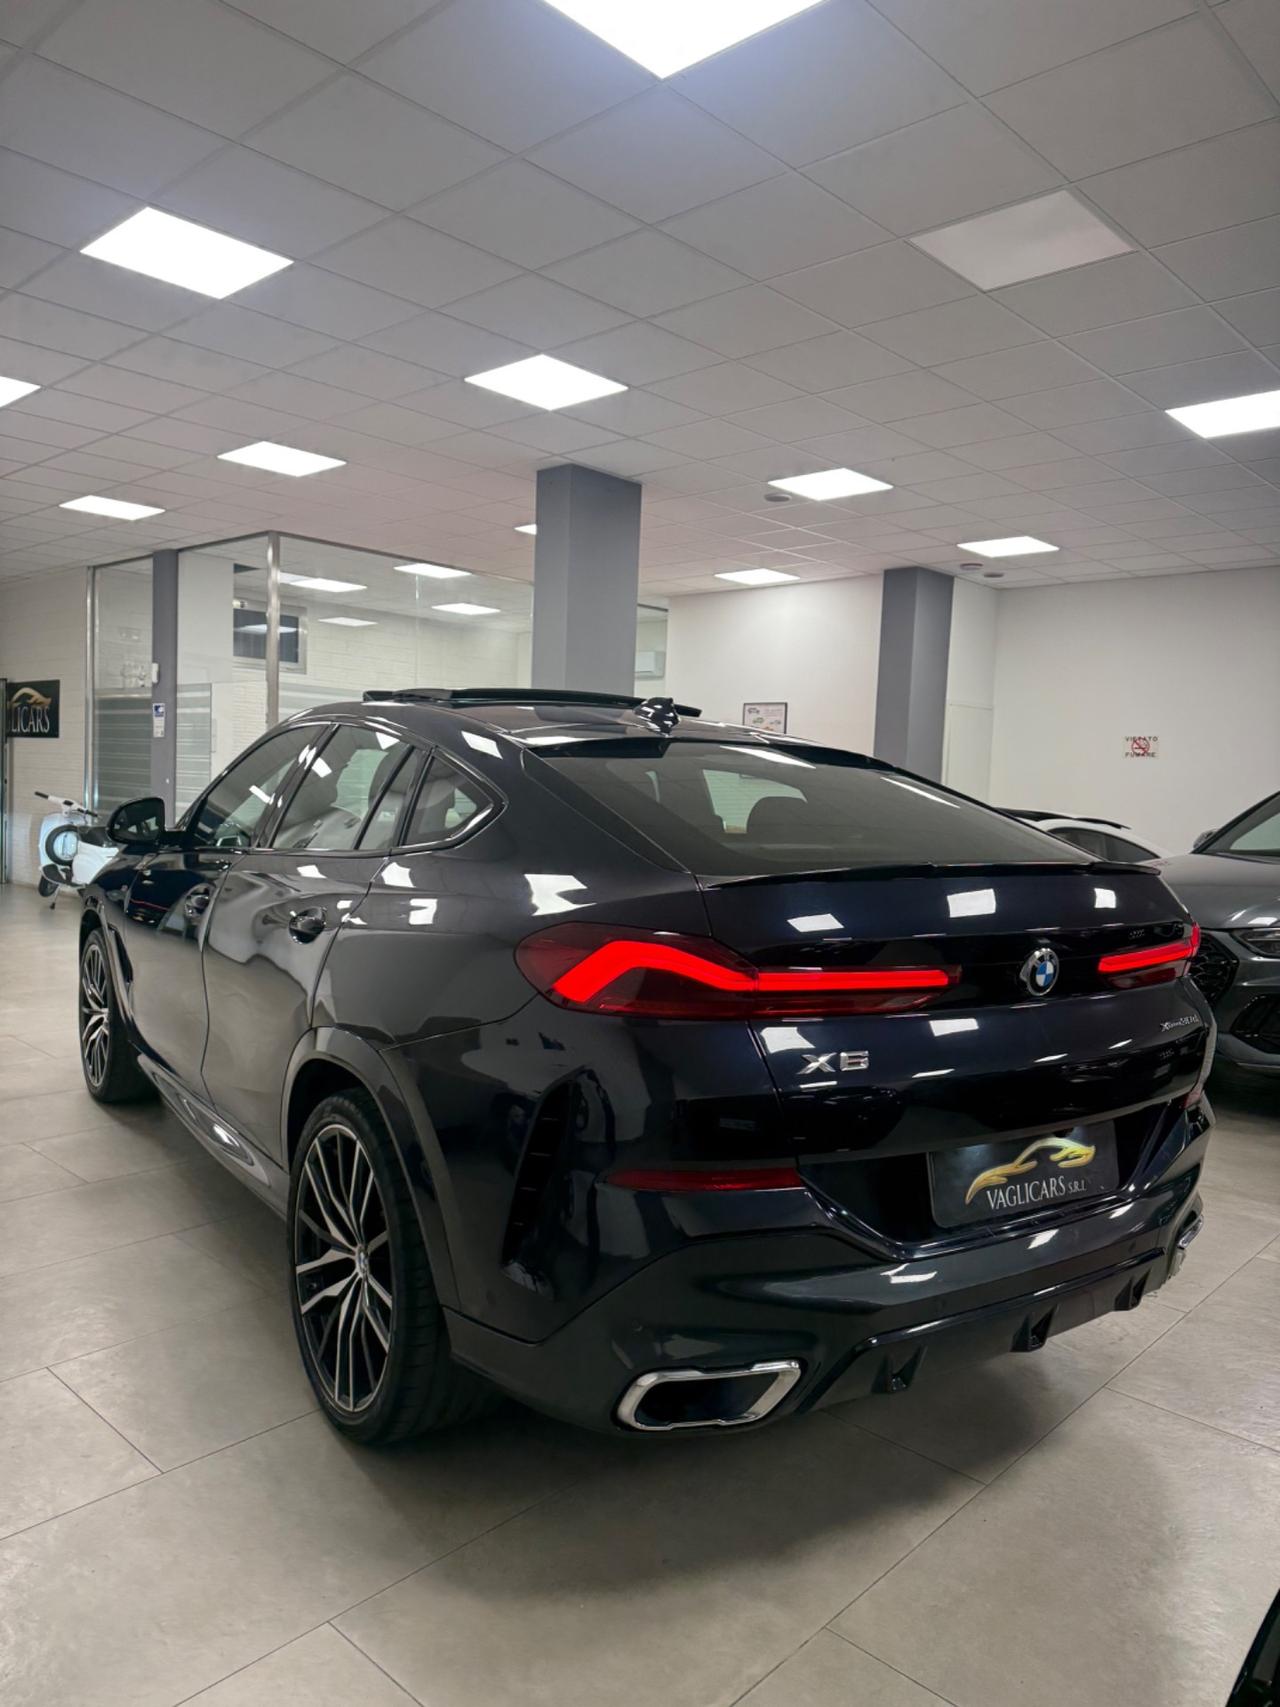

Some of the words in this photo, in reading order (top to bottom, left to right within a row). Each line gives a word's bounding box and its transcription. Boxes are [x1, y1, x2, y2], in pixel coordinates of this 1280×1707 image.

[8, 706, 50, 732] LICARS
[797, 1051, 869, 1075] X6
[987, 1176, 1066, 1210] VAGLICARS
